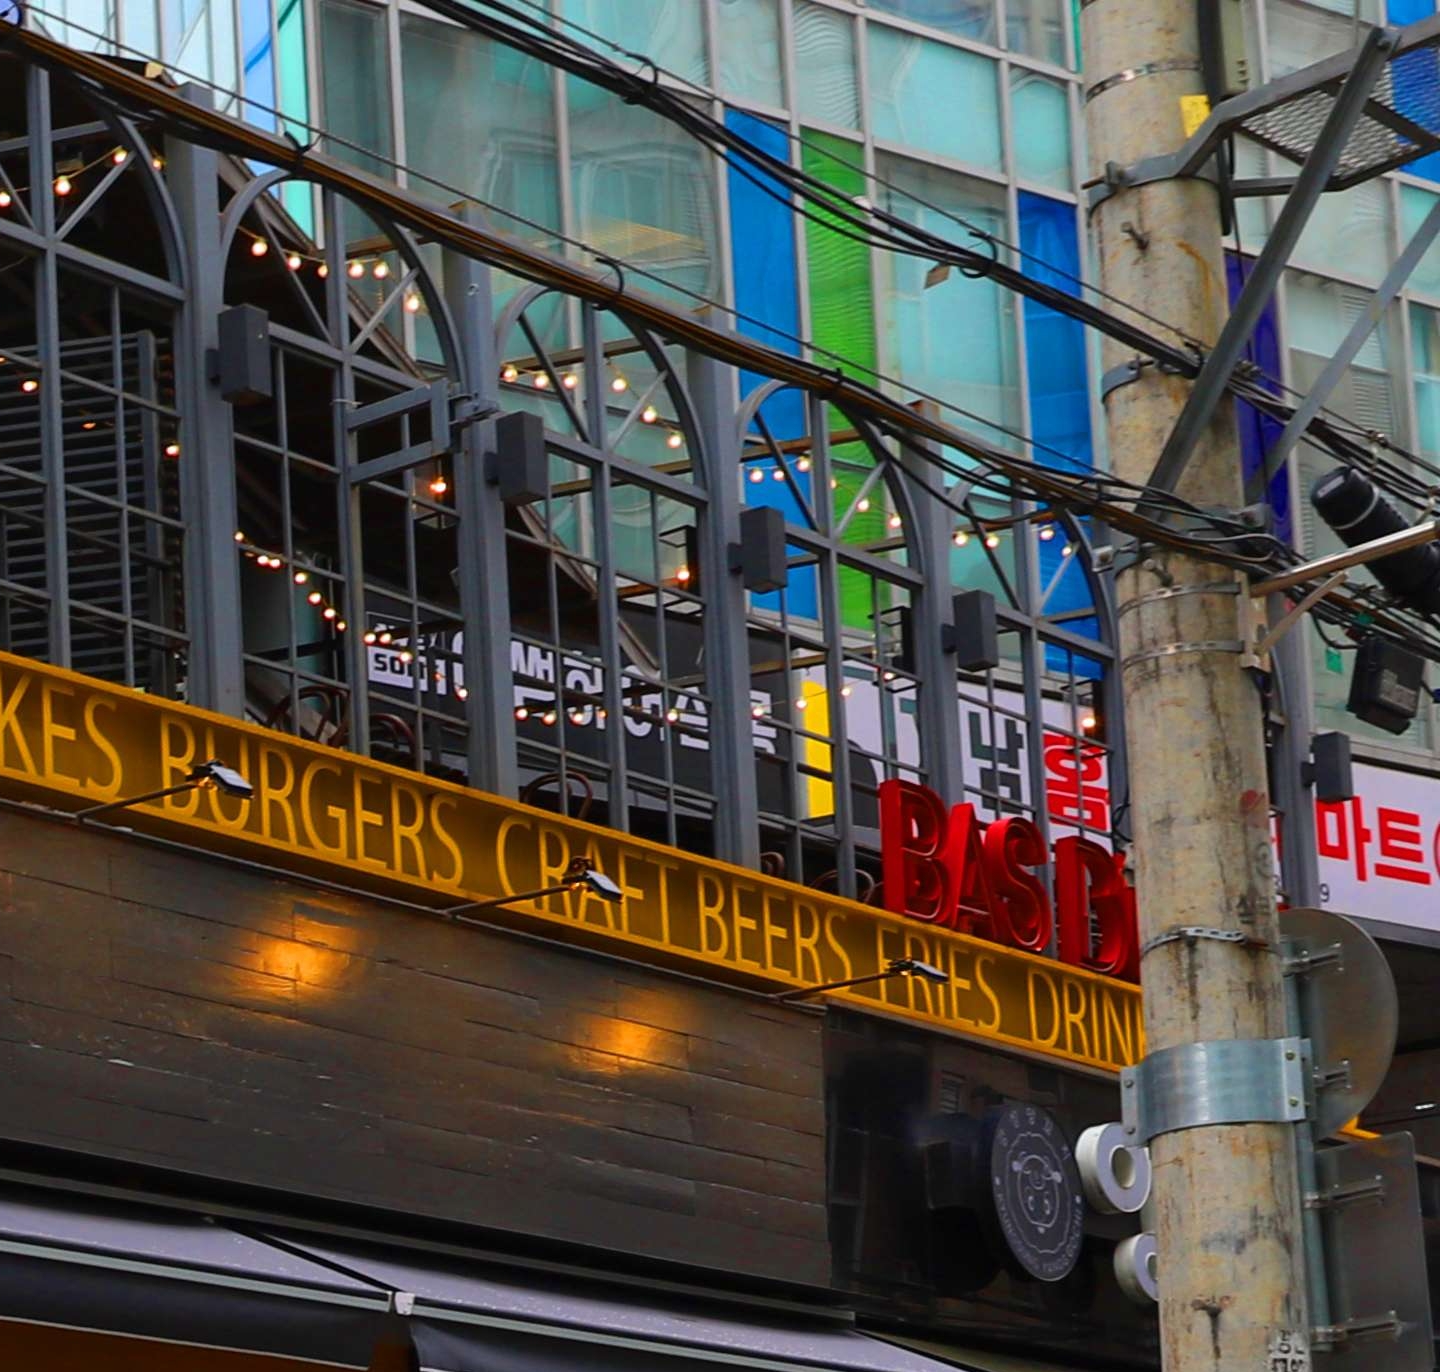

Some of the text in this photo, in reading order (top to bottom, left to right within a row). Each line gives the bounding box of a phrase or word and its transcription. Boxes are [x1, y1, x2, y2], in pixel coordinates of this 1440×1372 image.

[161, 713, 464, 890] BURGERS
[496, 815, 679, 947] CRAFT
[695, 878, 853, 986] BEERS
[877, 924, 1001, 1032] FRIES
